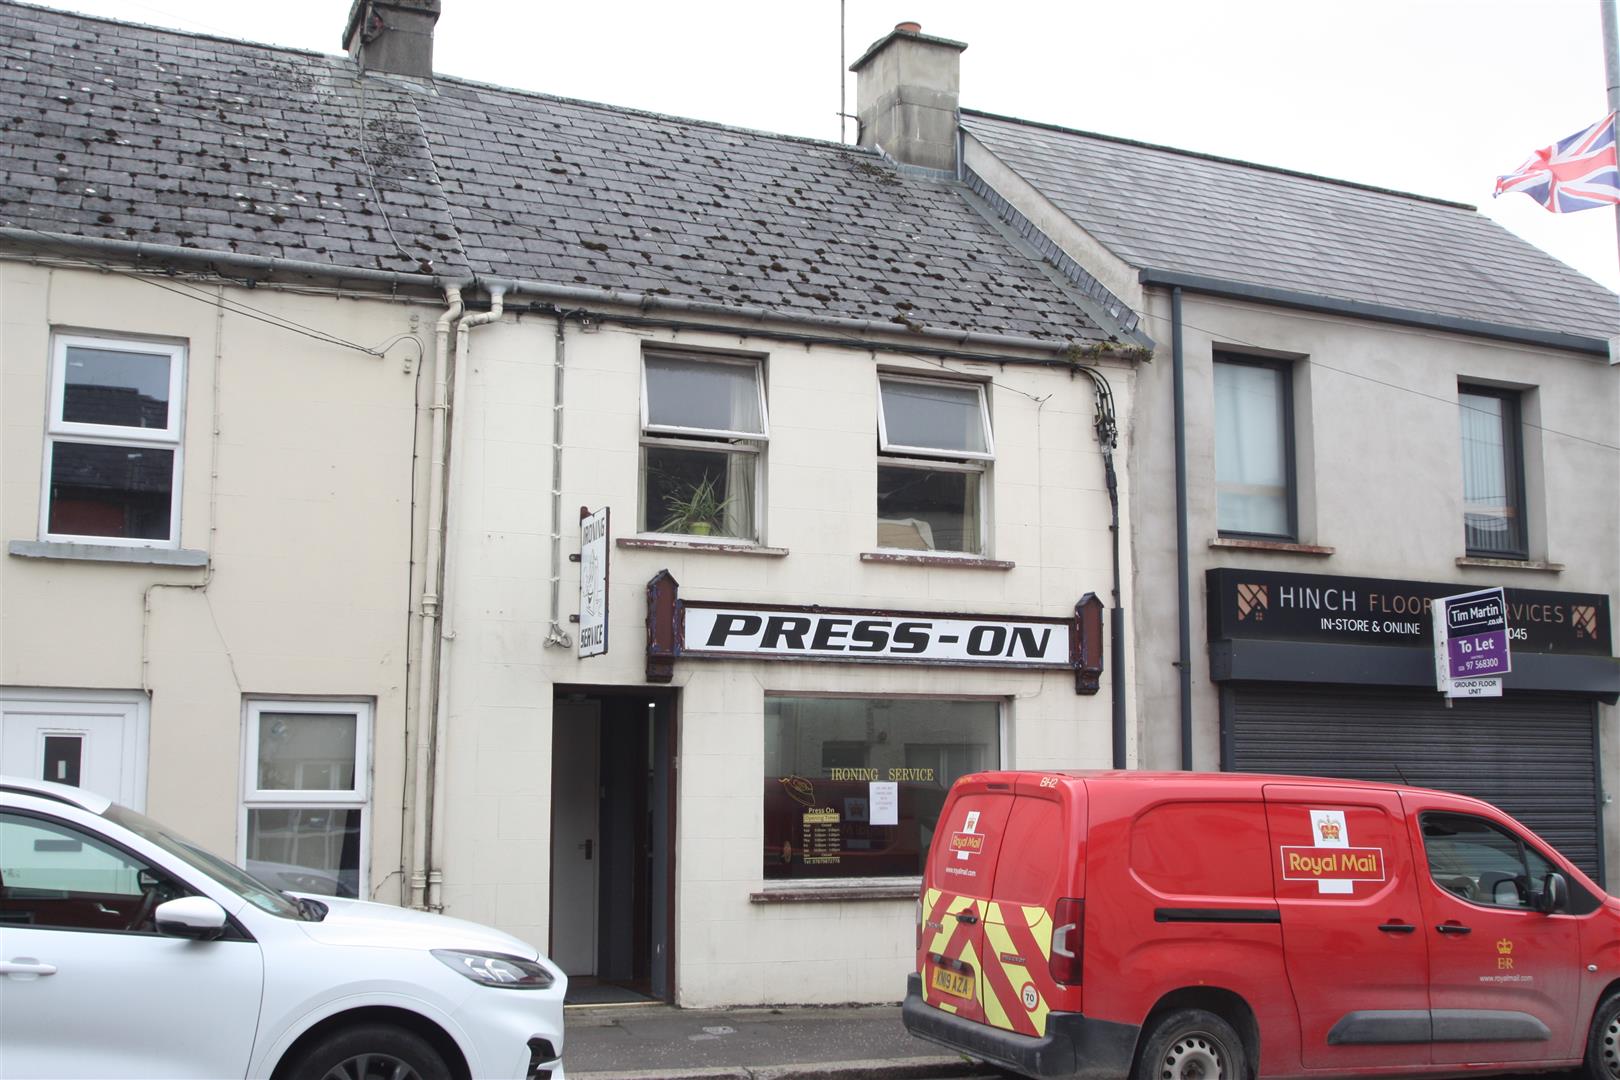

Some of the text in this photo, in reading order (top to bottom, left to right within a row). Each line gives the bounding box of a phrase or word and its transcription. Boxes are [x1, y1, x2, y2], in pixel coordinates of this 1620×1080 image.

[583, 517, 605, 546] IRONING
[1279, 586, 1356, 611] HINCH
[1369, 594, 1432, 616] FLOOR
[1451, 604, 1499, 622] Tim Martin
[1487, 616, 1504, 626] .co.uk
[1320, 618, 1369, 632] IN-STORE
[1371, 620, 1381, 633] &
[1383, 621, 1421, 634] ONLINE
[580, 624, 603, 648] SERVICE
[705, 614, 1052, 658] PRESS-ON
[1458, 638, 1495, 653] To Let
[1465, 661, 1474, 670] 97
[1475, 658, 1499, 669] 568300
[831, 768, 934, 781] IRONING SERVICE
[952, 835, 982, 848] Royal Mail
[1289, 852, 1377, 876] Royal Mail
[951, 975, 968, 994] AZA
[1479, 974, 1533, 983] www.royalmail.com
[1025, 992, 1035, 1002] 70
